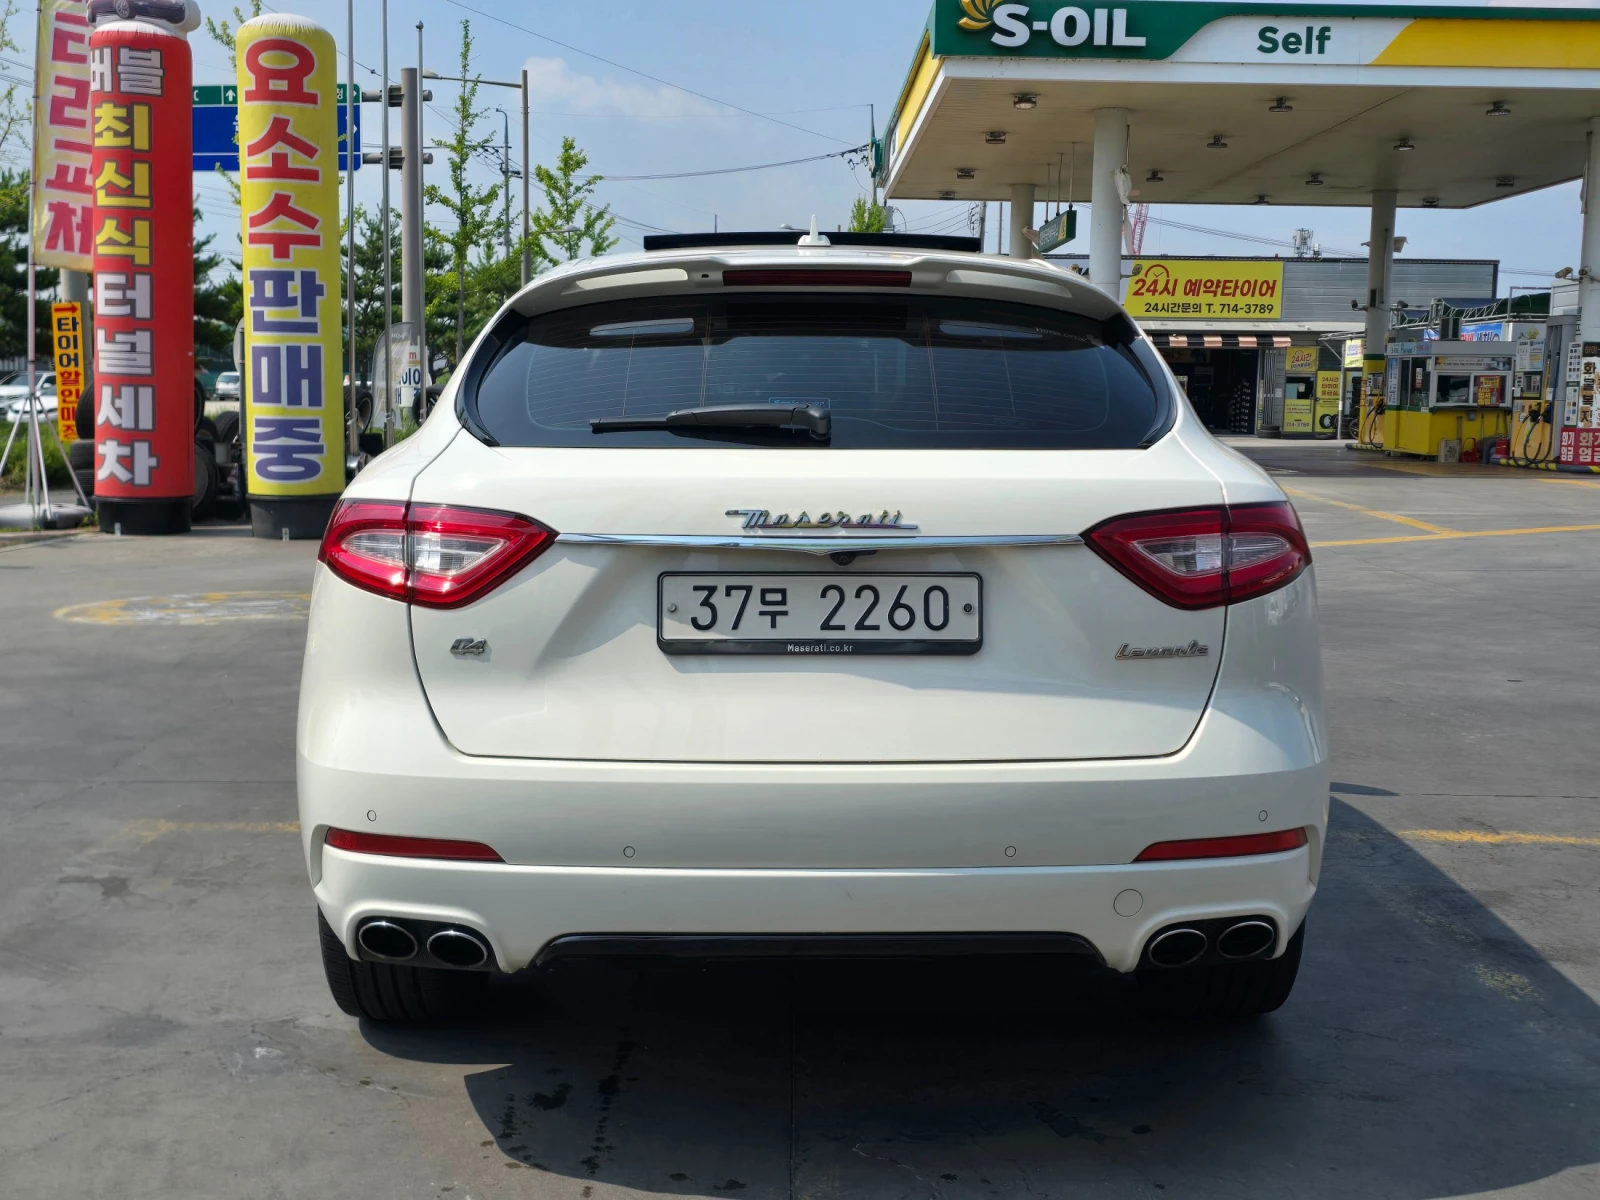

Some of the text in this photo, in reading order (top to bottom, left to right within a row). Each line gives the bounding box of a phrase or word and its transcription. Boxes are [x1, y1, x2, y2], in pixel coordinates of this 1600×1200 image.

[989, 3, 1146, 47] S-OIL
[1256, 26, 1331, 55] Self
[1132, 278, 1277, 297] 24시 예약타이어
[1144, 302, 1274, 314] 24시간문의 T. 714-3789
[725, 509, 919, 529] Maserati
[691, 584, 949, 631] 37무 2260
[787, 644, 853, 653] Maserati.co.kr
[1115, 639, 1208, 660] Levante
